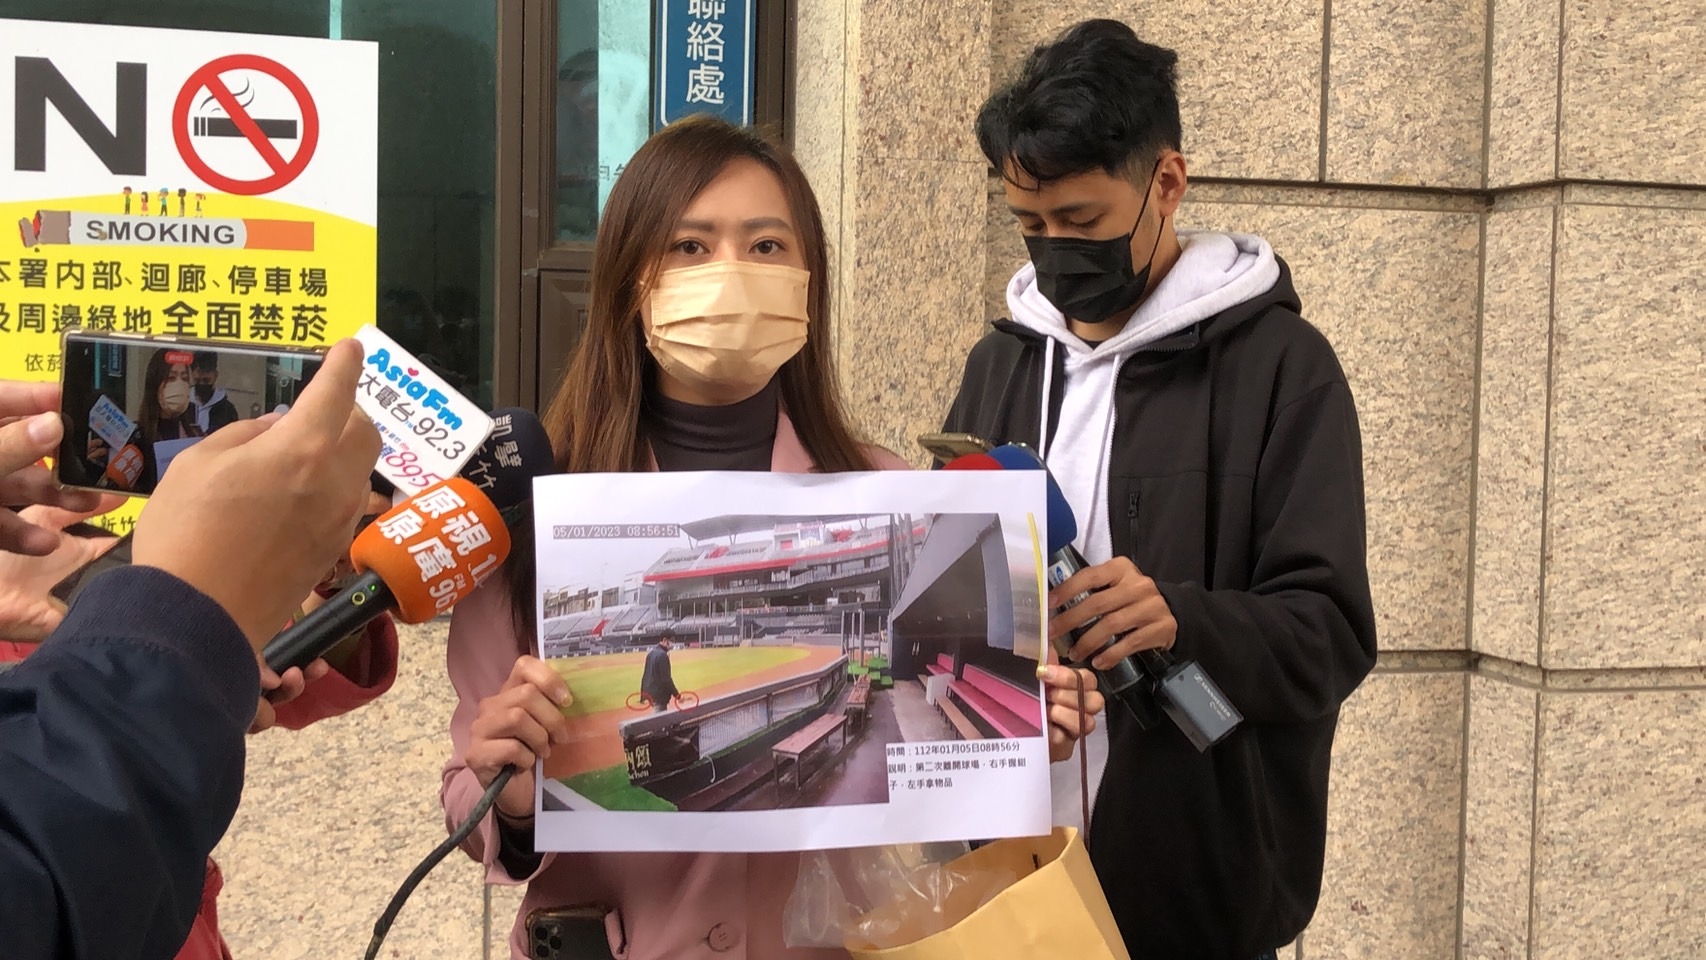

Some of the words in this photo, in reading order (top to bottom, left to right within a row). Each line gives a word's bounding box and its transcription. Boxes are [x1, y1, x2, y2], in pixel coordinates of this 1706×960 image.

[86, 220, 235, 244] SMOKING
[367, 348, 463, 431] AsiaFm
[413, 417, 466, 460] 92.3
[385, 451, 443, 488] 89.5
[411, 485, 492, 556] 原視
[554, 526, 620, 537] 05/01/2023
[627, 525, 679, 536] 08:56:51
[376, 508, 457, 583] 原廣
